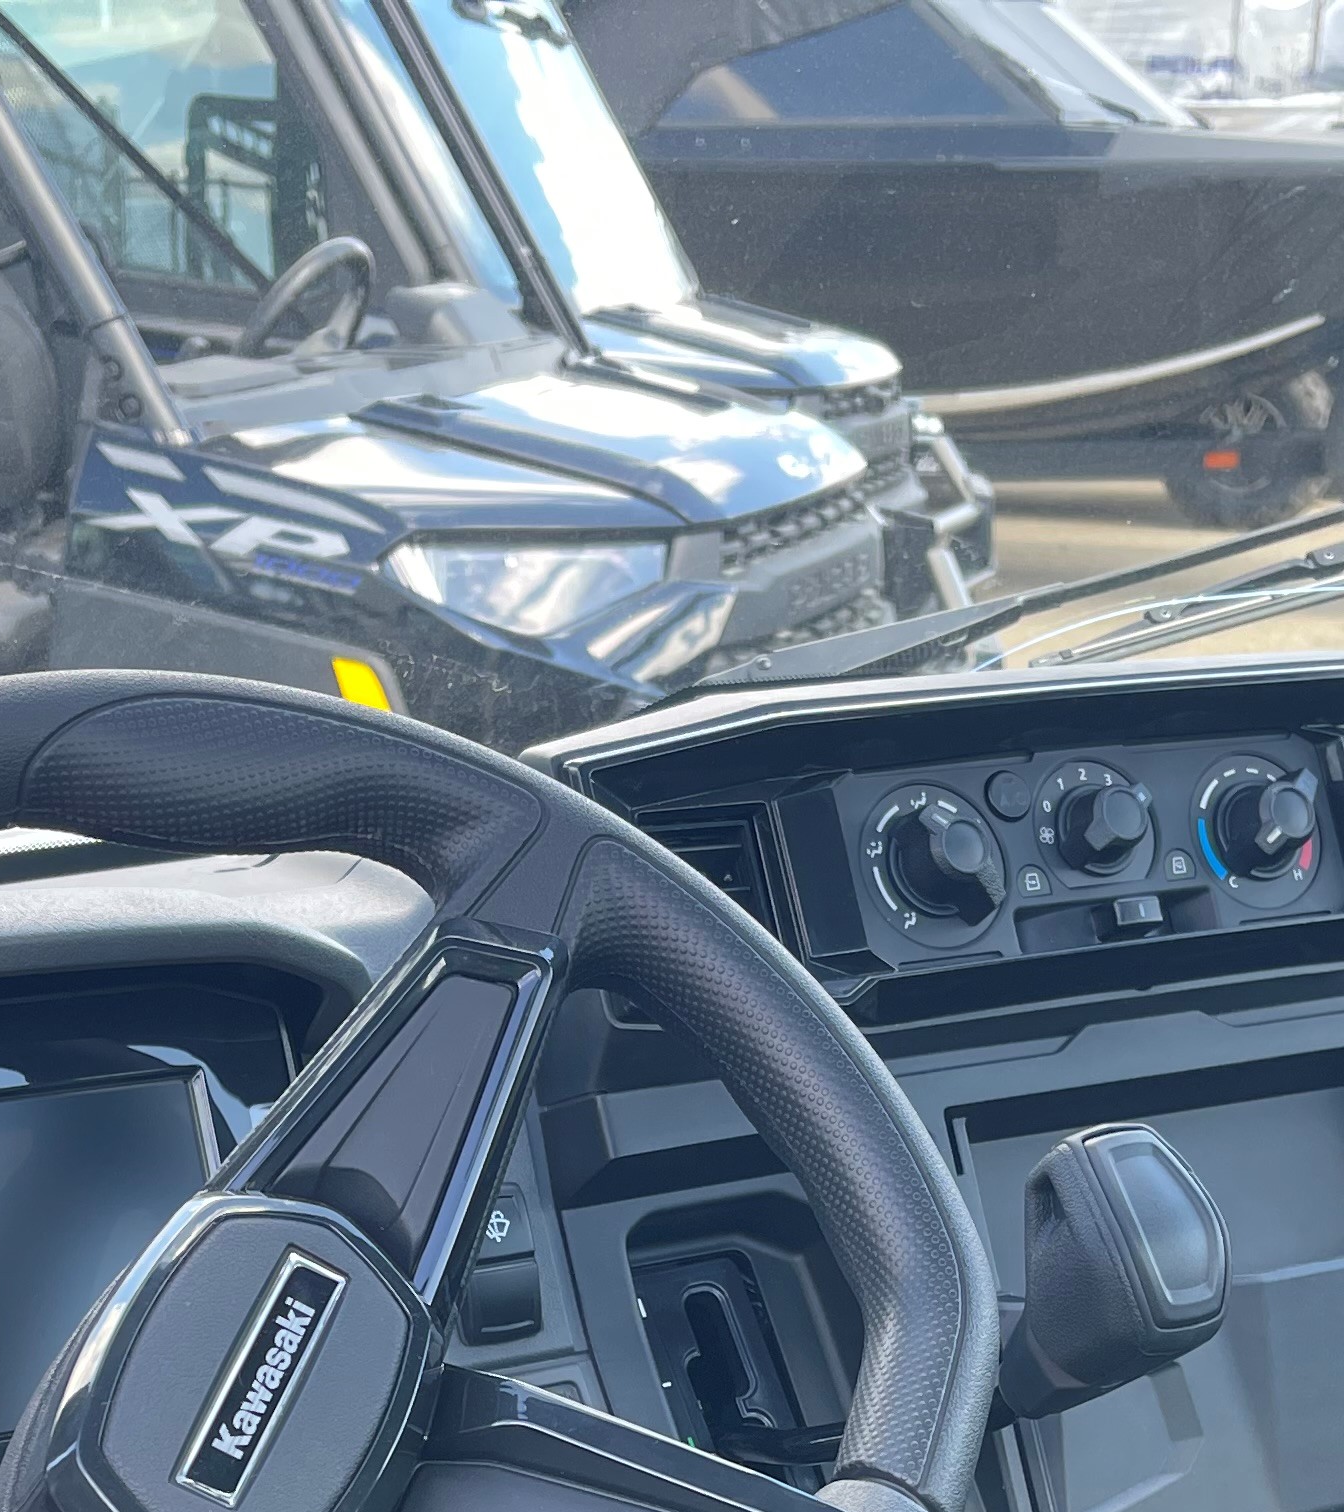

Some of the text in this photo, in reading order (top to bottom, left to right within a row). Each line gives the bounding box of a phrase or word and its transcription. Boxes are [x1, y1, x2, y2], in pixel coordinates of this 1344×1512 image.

[1056, 777, 1065, 790] 1
[1077, 768, 1088, 781] 2
[1103, 773, 1113, 786] 3
[1292, 867, 1304, 881] H
[211, 1296, 316, 1460] Kawasaki
